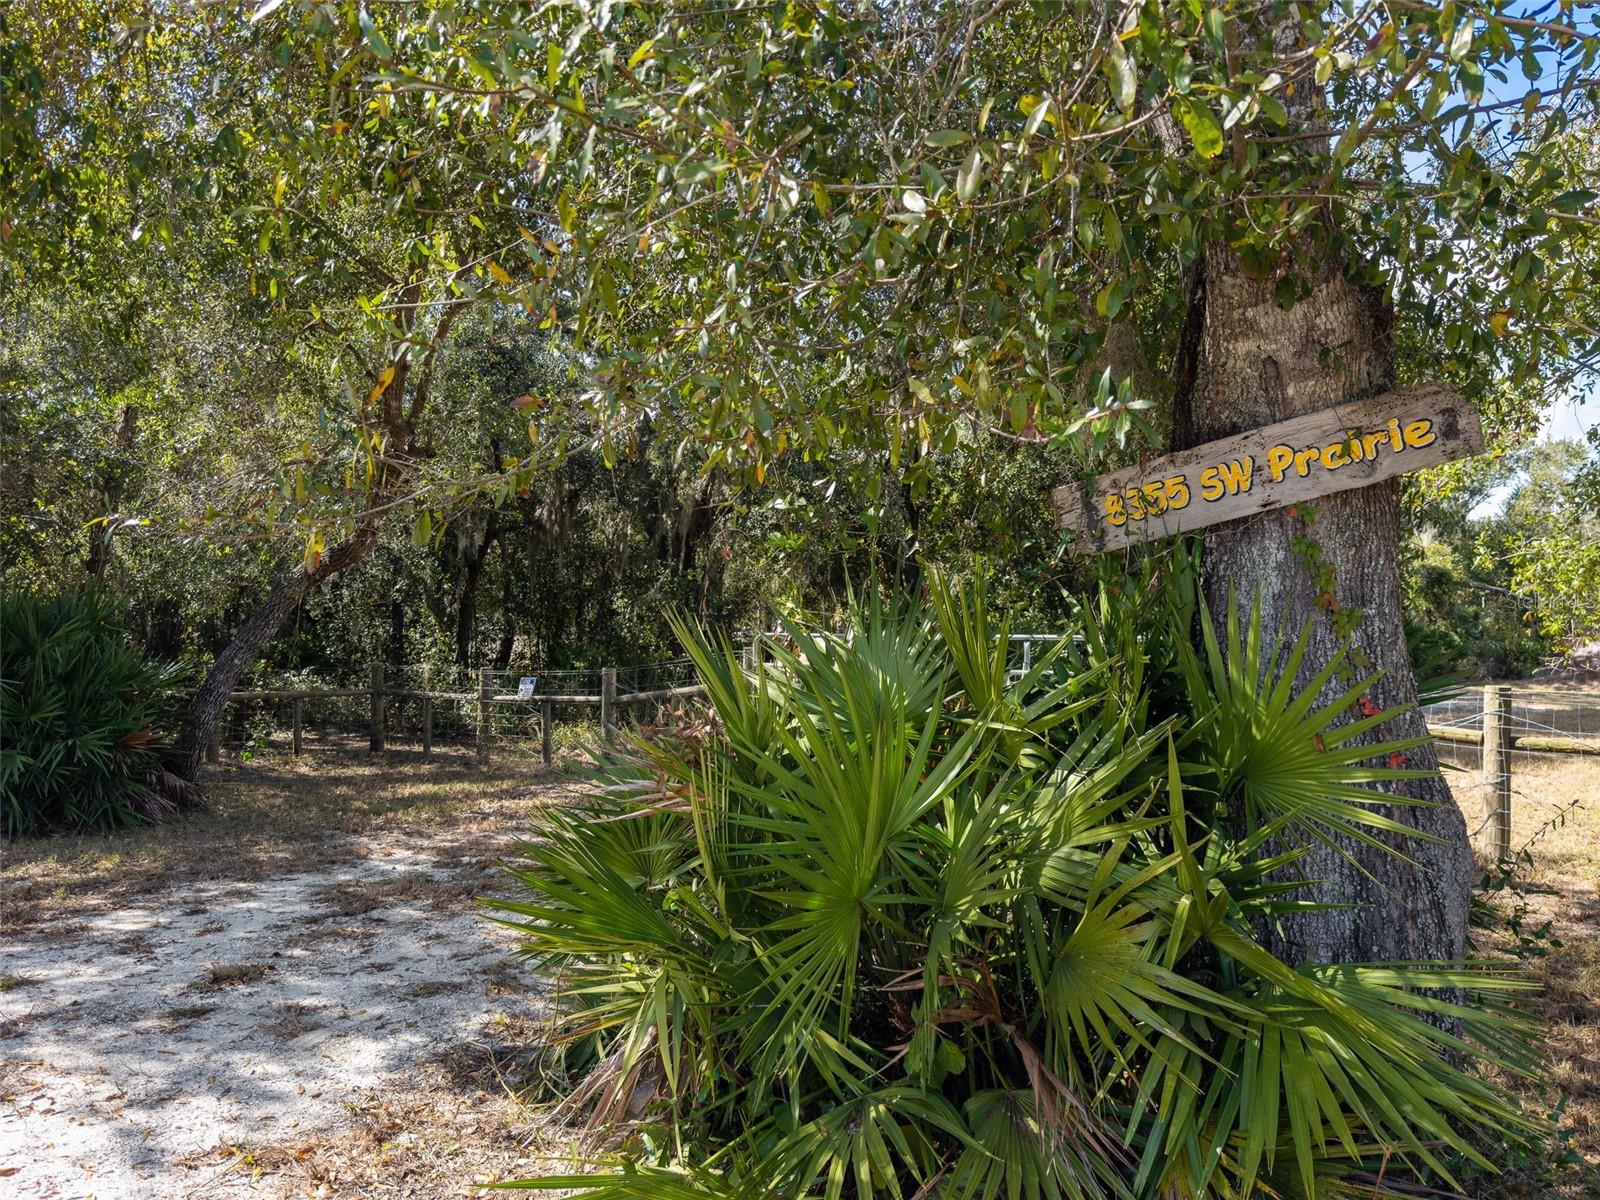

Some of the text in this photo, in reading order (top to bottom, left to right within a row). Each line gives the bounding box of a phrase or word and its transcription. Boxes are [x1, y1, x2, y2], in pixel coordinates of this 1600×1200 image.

[1104, 418, 1437, 526] 8355 SW Prairie
